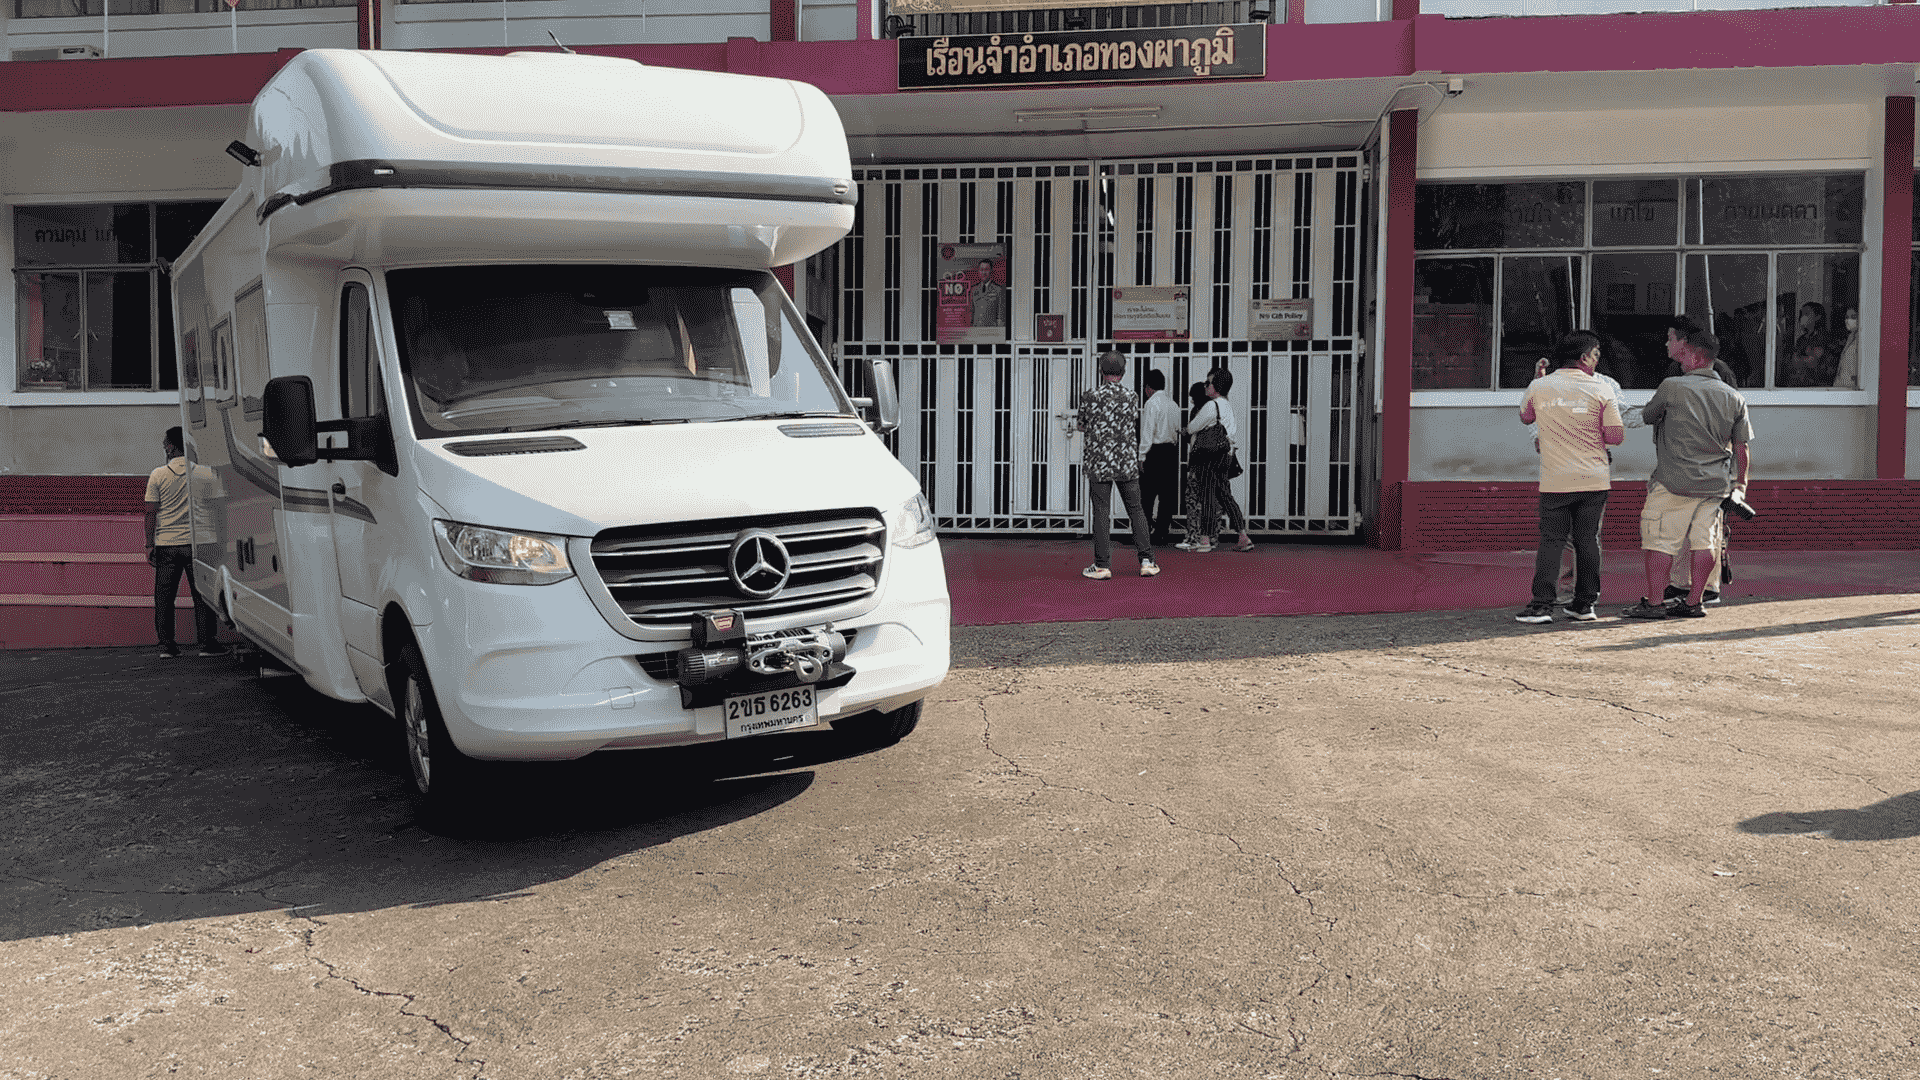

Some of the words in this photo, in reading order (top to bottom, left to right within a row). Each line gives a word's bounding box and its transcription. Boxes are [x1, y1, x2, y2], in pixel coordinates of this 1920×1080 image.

[926, 26, 1235, 76] เรือนจำอำเภอทองผาภูมิ
[944, 283, 963, 295] NO
[1284, 313, 1303, 321] Policy
[729, 695, 766, 720] 2ขธ
[769, 688, 812, 712] 6263
[740, 714, 804, 732] กรุงเทพมหานคร
